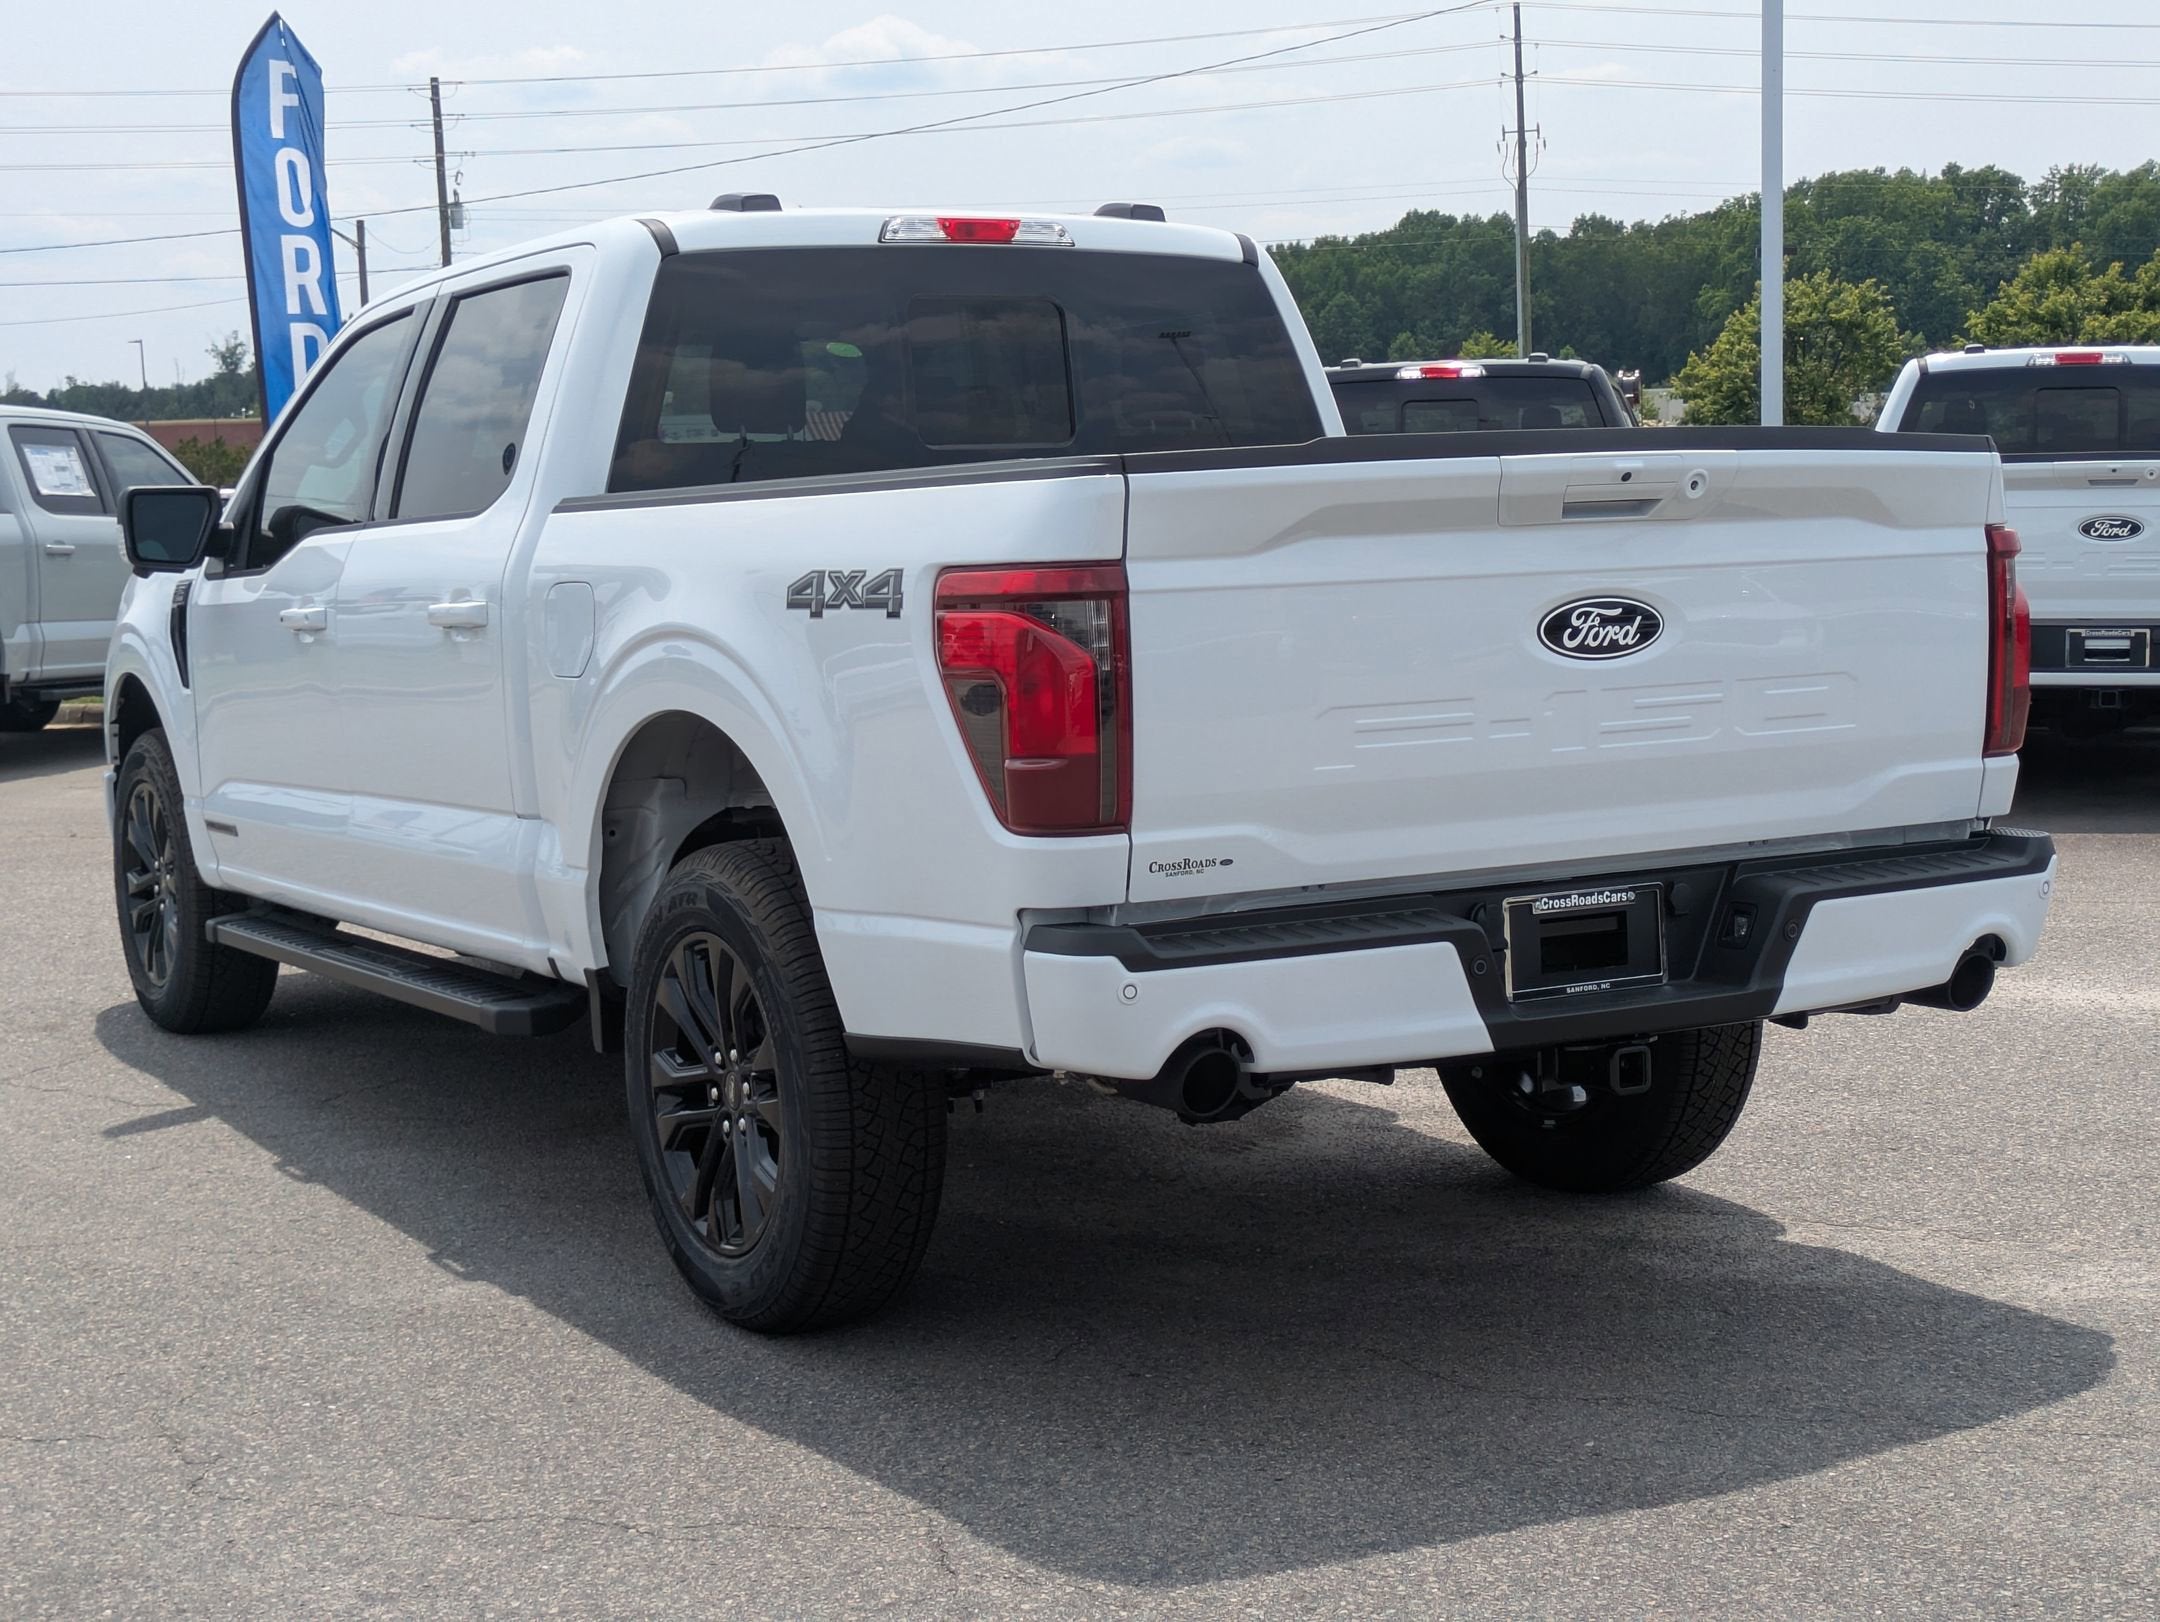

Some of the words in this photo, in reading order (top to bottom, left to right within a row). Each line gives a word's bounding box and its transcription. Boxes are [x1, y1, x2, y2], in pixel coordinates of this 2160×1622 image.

[2090, 520, 2132, 537] Ford
[1563, 607, 1642, 648] Ford
[1541, 891, 1627, 909] CrossRoadsCars
[1601, 982, 1611, 990] NC
